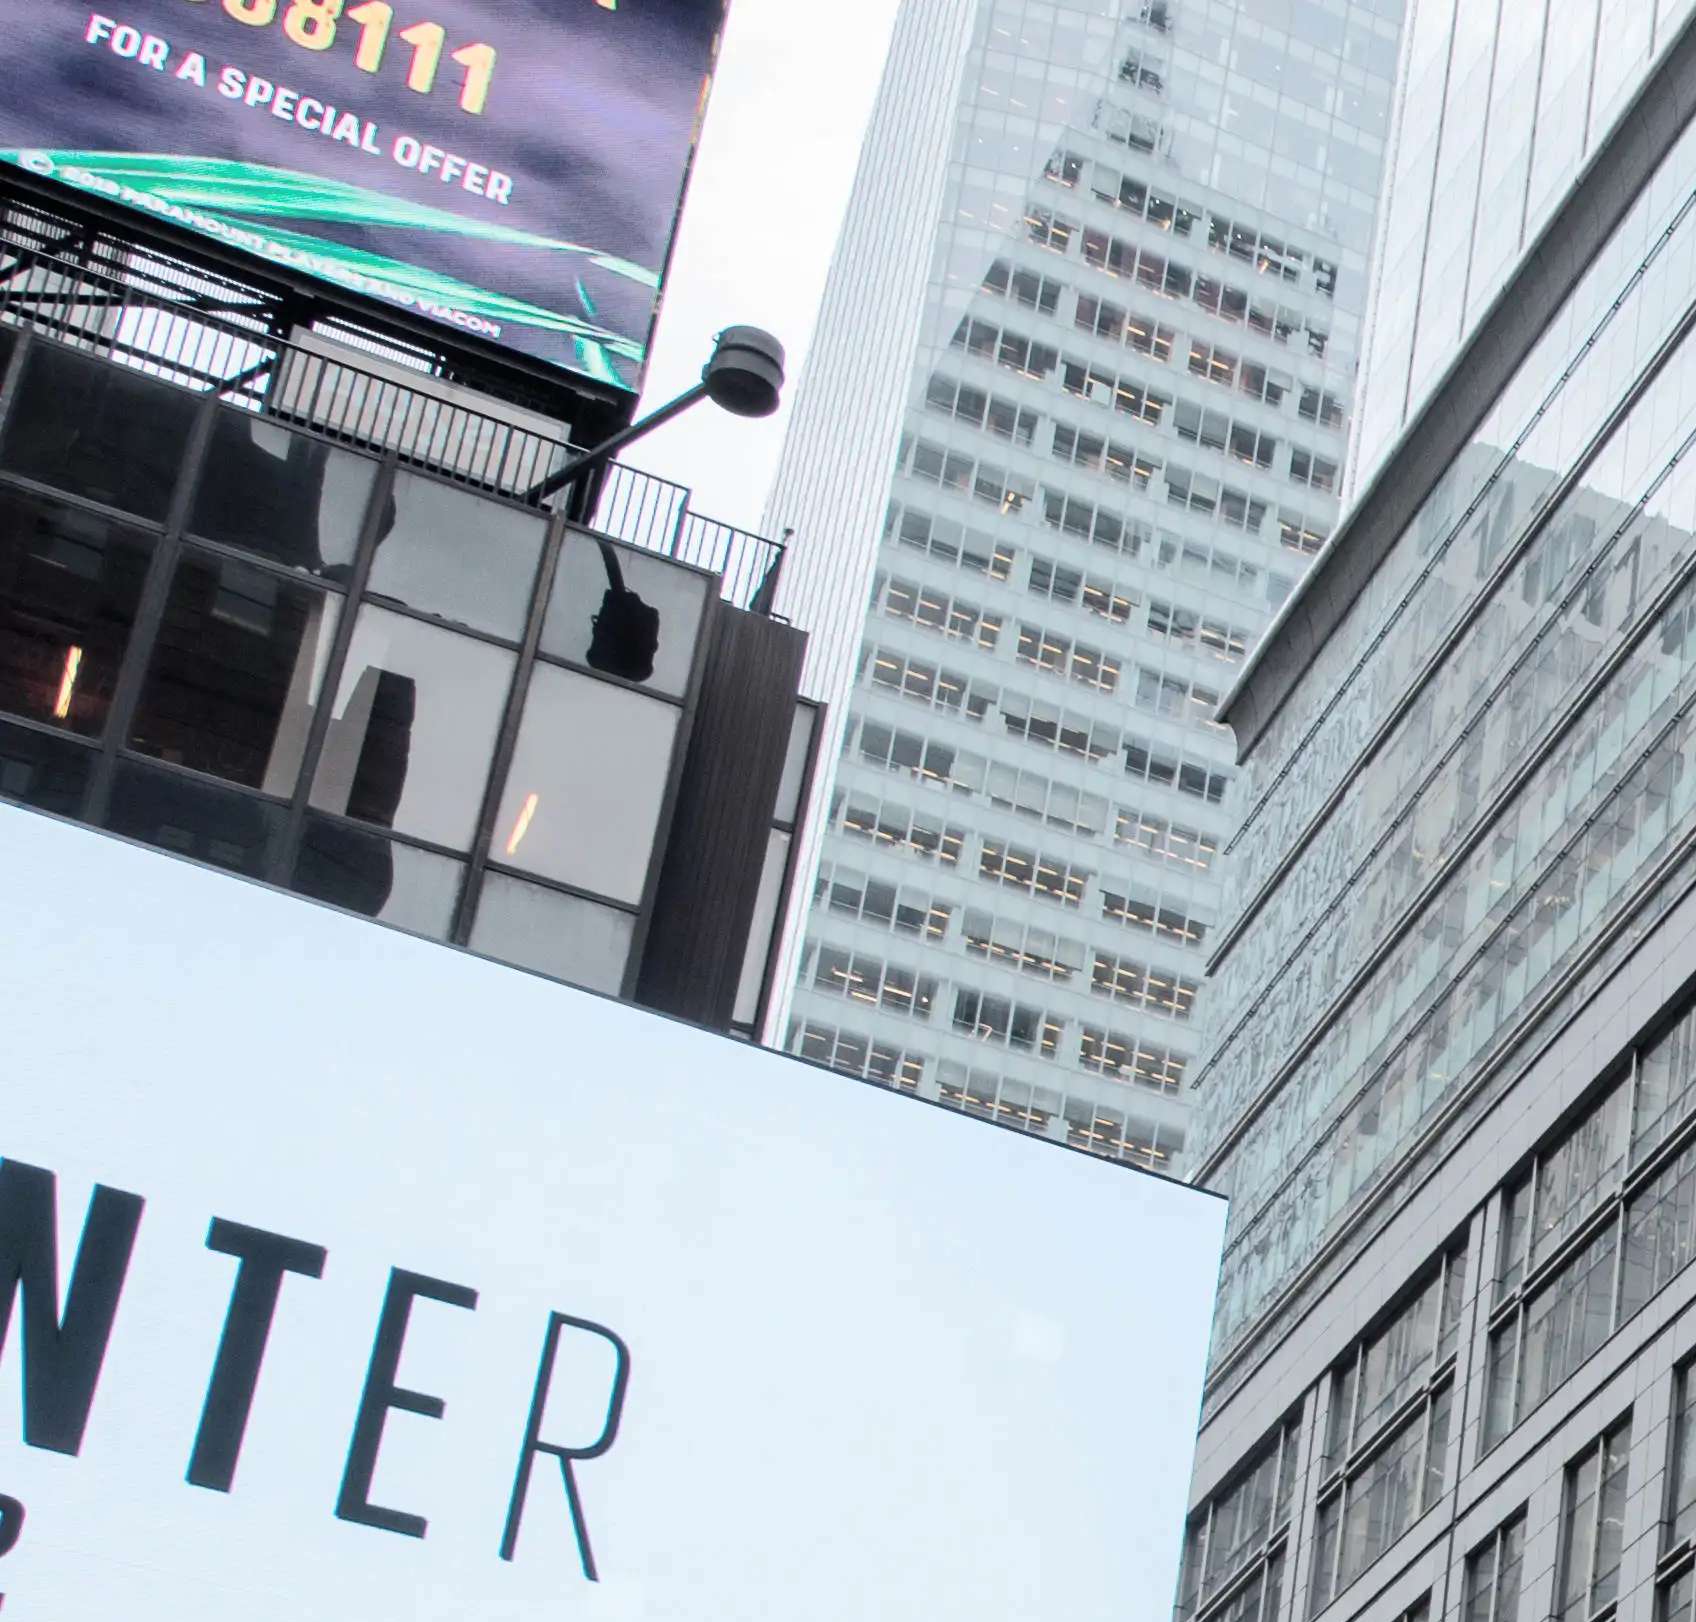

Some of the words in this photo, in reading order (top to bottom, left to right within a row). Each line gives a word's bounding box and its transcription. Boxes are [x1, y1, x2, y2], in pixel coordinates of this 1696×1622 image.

[84, 14, 168, 70] FOR
[178, 51, 207, 87] A
[217, 64, 382, 155] SPECIAL
[391, 135, 515, 205] OFFER
[121, 187, 266, 250] PARAMOUNT
[415, 296, 501, 338] VIACOM
